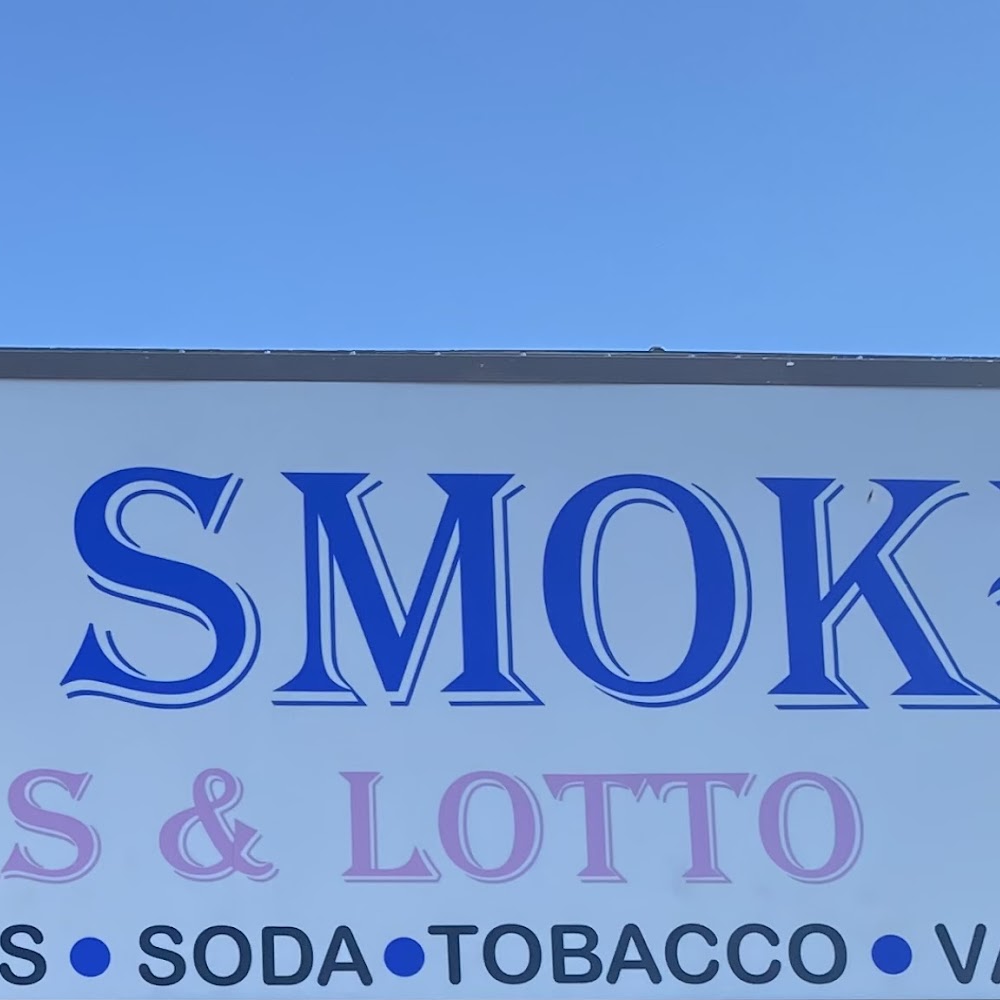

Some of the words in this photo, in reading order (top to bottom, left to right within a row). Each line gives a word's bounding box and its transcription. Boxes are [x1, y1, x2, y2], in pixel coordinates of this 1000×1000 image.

[60, 466, 1000, 711] SMOK
[159, 768, 279, 883] &
[339, 770, 865, 885] LOTTO
[138, 924, 373, 987] SODA
[427, 922, 848, 986] TOBACCO
[934, 922, 1000, 985] V
